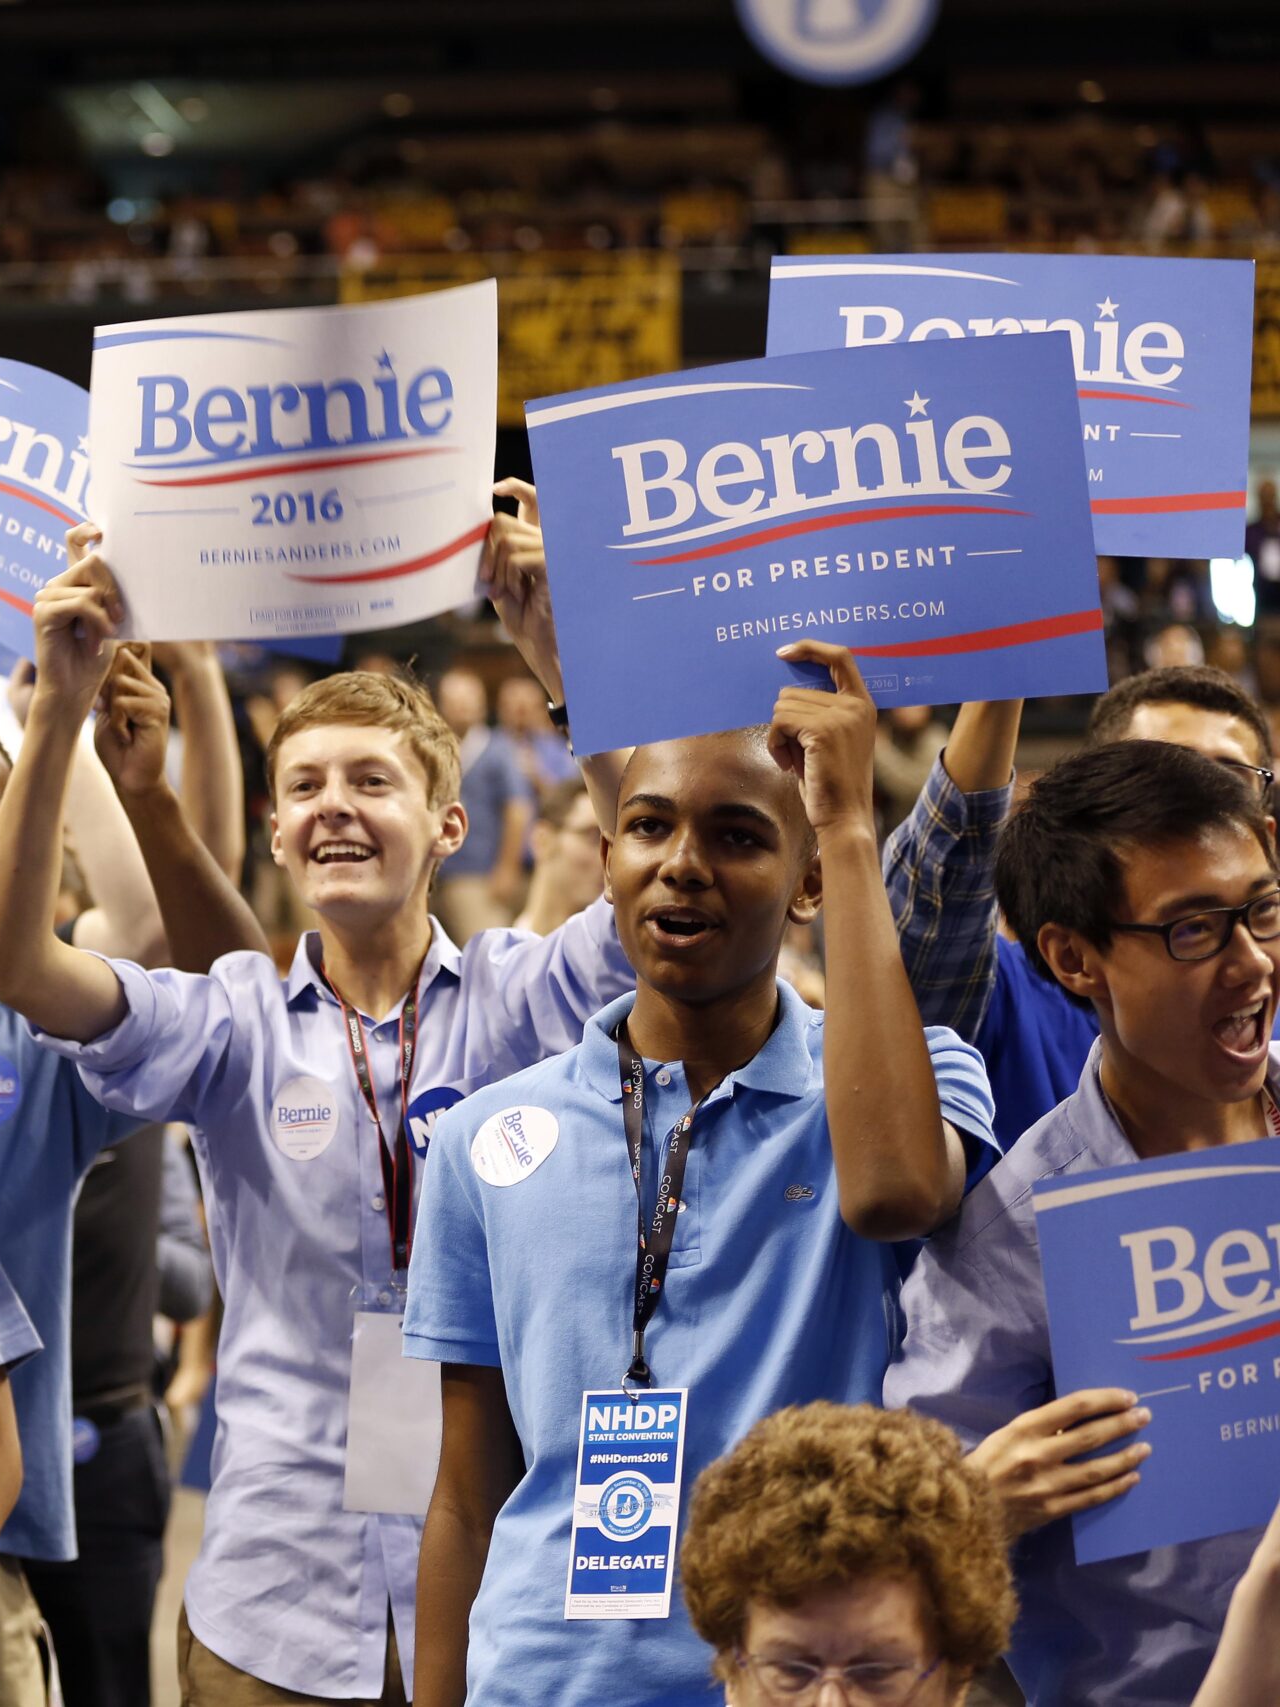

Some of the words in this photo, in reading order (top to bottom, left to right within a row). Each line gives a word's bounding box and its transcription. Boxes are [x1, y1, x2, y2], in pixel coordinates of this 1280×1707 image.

[134, 348, 454, 460] Bernie
[611, 390, 1013, 537] Bernie
[251, 488, 344, 527] 2016
[199, 535, 402, 566] BERNIESANDERS.COM
[692, 568, 754, 596] FOR
[769, 545, 957, 583] PRESIDENT
[716, 601, 947, 642] BERNIESANDERS.COM
[871, 680, 893, 689] 2016
[631, 1058, 643, 1110] COMCAST
[278, 1104, 332, 1123] Bernie
[652, 1175, 672, 1234] COMCAST
[1199, 1362, 1260, 1394] FOR
[588, 1404, 678, 1431] NHDP
[588, 1433, 615, 1442] STATE
[616, 1431, 674, 1441] CONVENTION
[590, 1453, 669, 1465] #NHDems2016
[576, 1555, 666, 1570] DELEGATE
